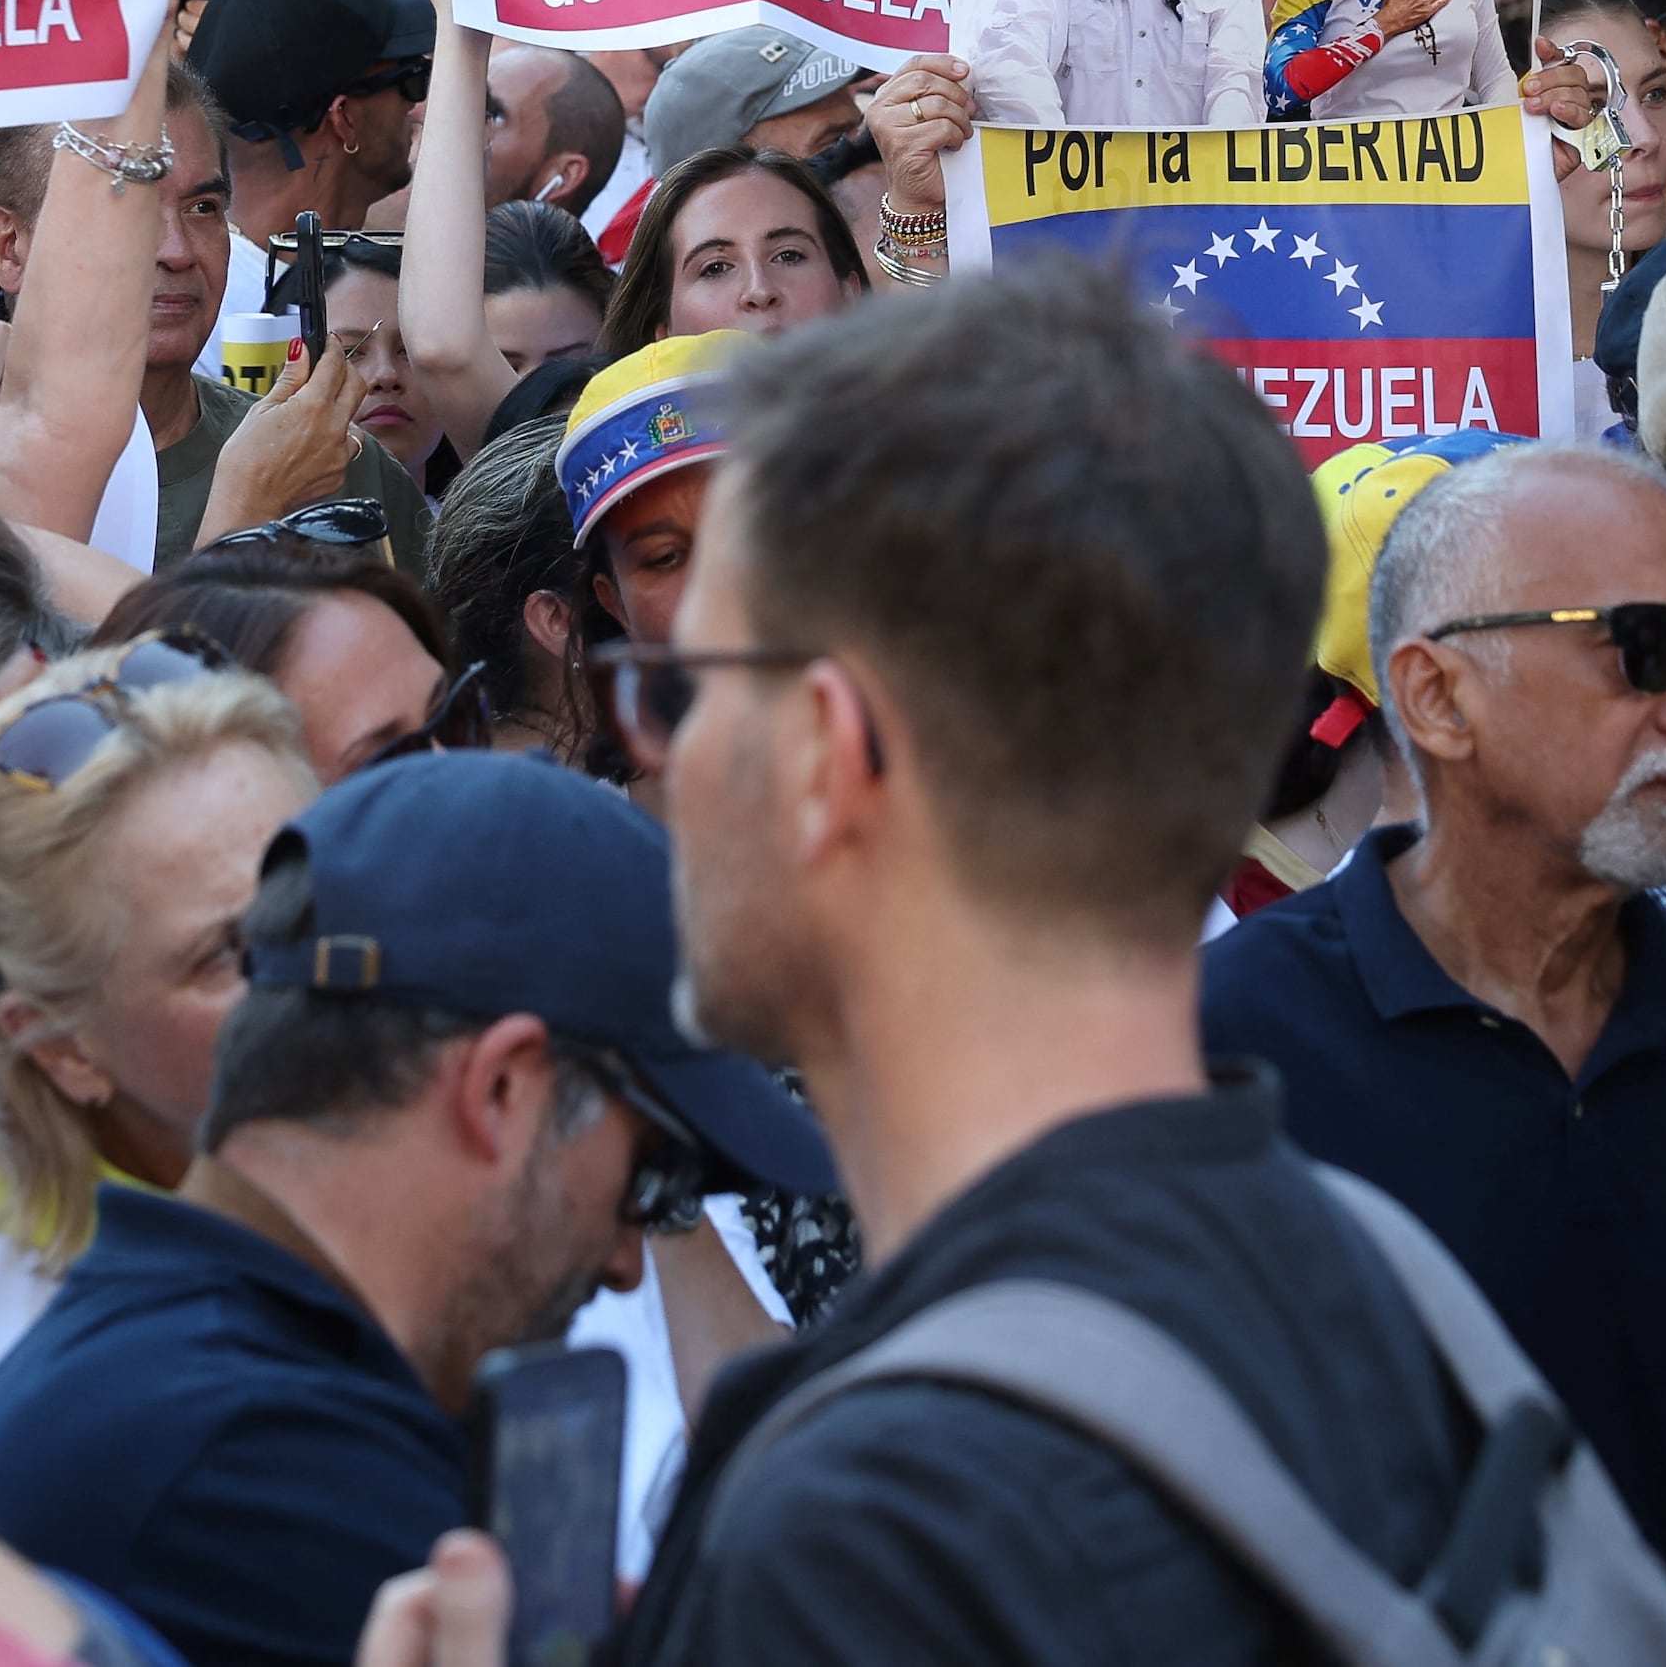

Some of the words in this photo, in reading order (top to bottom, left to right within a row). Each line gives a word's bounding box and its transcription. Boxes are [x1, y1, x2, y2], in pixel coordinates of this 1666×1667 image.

[1025, 128, 1112, 197] Por
[1147, 130, 1190, 183] la
[1227, 113, 1485, 183] LIBERTAD
[1236, 366, 1499, 438] EZUELA
